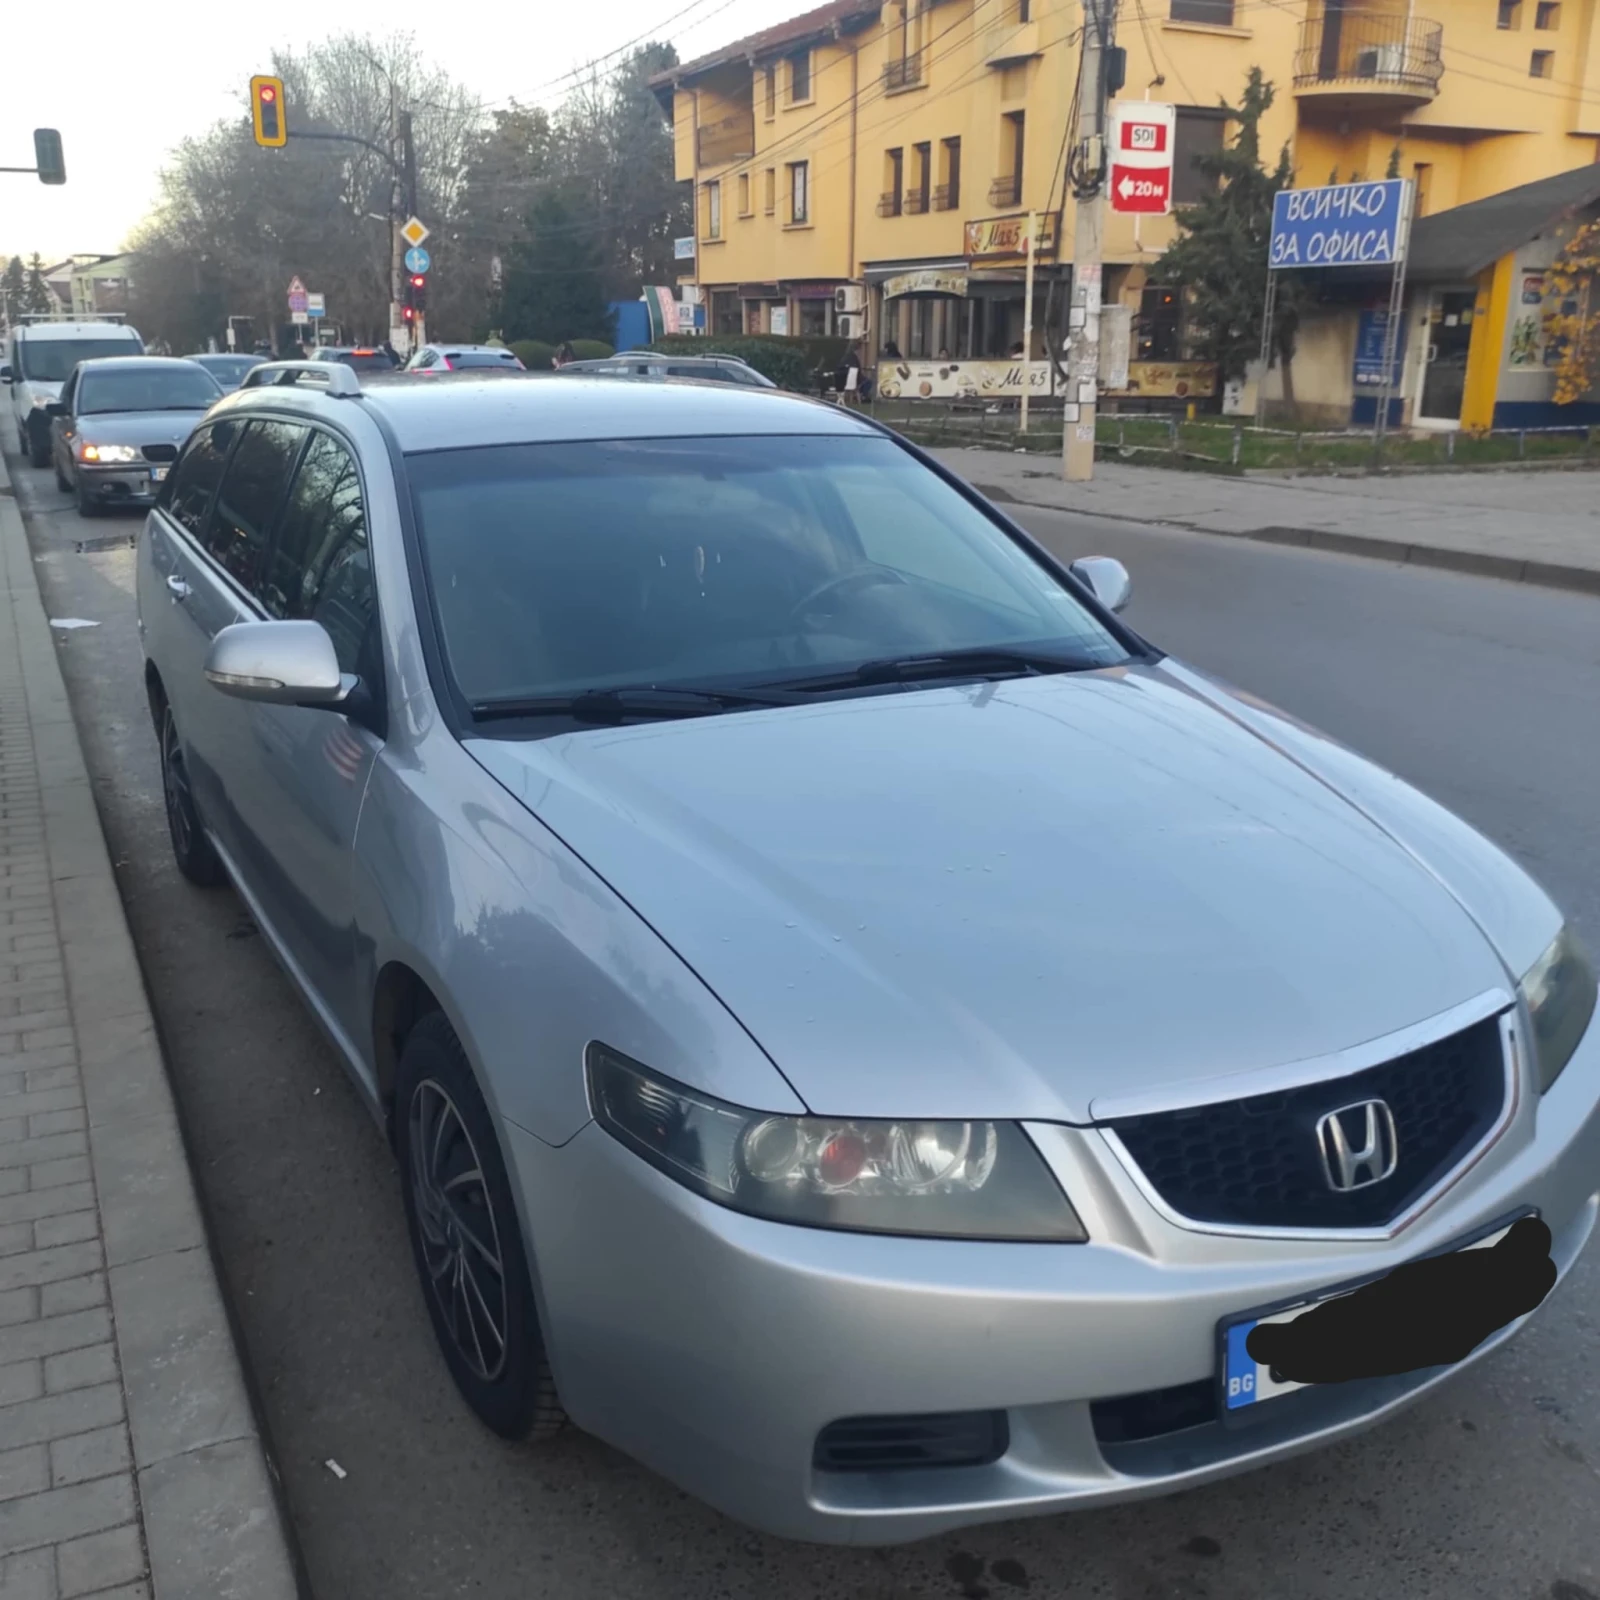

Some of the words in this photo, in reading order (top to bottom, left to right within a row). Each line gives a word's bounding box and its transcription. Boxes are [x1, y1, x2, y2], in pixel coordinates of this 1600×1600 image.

[1135, 129, 1154, 142] SDI
[1287, 185, 1386, 221] ВСИЧКО
[1271, 232, 1300, 264] ЗА
[1307, 228, 1391, 264] ОФИСА
[1229, 1373, 1254, 1397] BG
